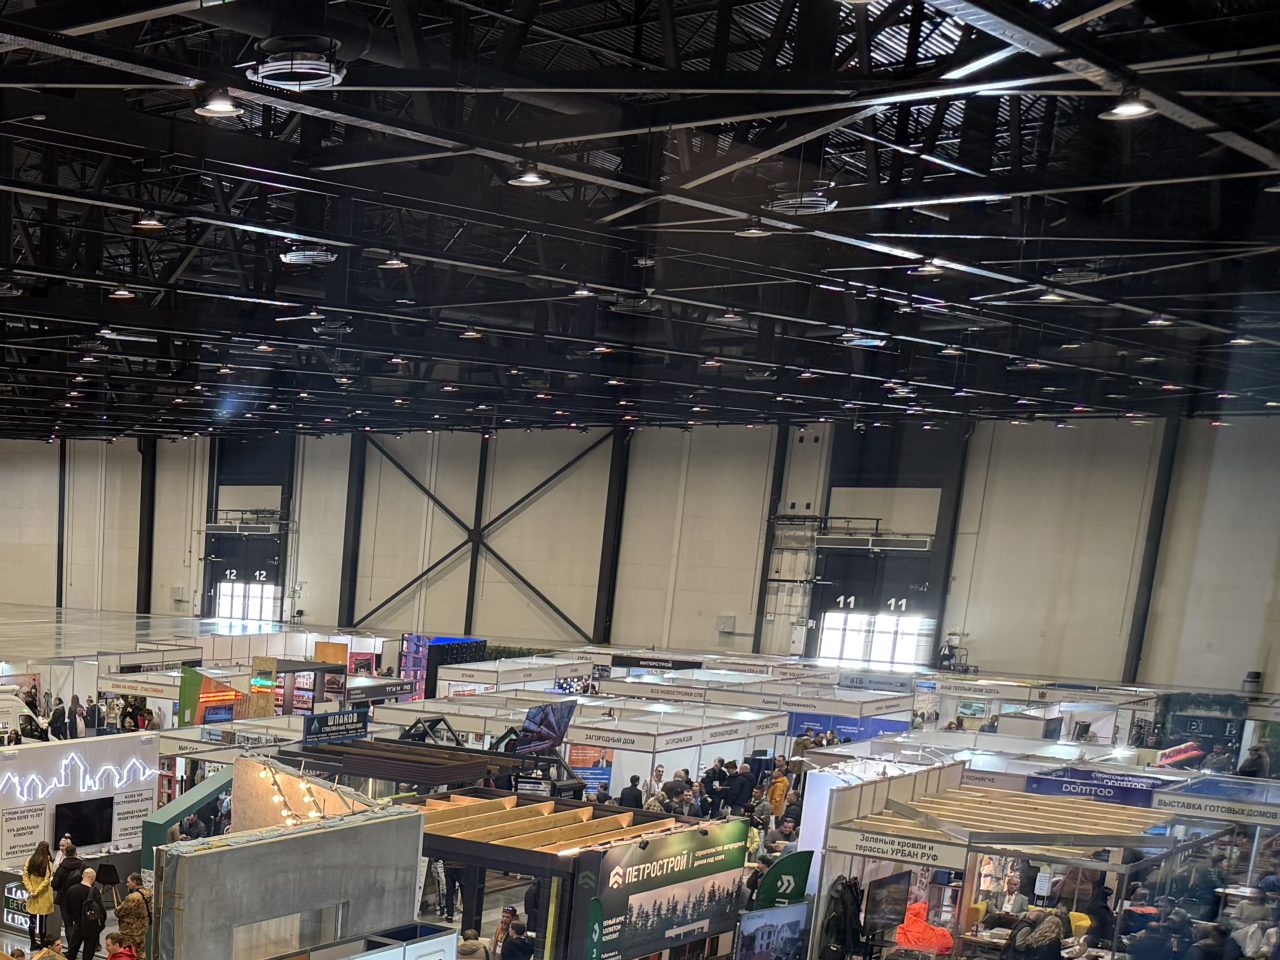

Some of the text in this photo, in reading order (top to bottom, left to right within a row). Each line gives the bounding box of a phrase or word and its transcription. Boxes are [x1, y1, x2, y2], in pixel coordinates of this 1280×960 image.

[224, 569, 237, 580] 12
[254, 570, 267, 581] 12
[836, 595, 855, 608] 11
[887, 598, 907, 611] 11
[328, 713, 358, 726] ШПАКОВ
[1157, 799, 1277, 819] ВЫСТАВКА ГОТОВЫХ ДОМОВ
[860, 833, 896, 846] Зеленые
[897, 840, 927, 851] кровли
[855, 843, 939, 862] терассы УРБАН РУФ
[625, 850, 688, 884] ПЕТРОСТРОЙ
[9, 899, 28, 912] БЕТО
[7, 913, 30, 928] СТРО
